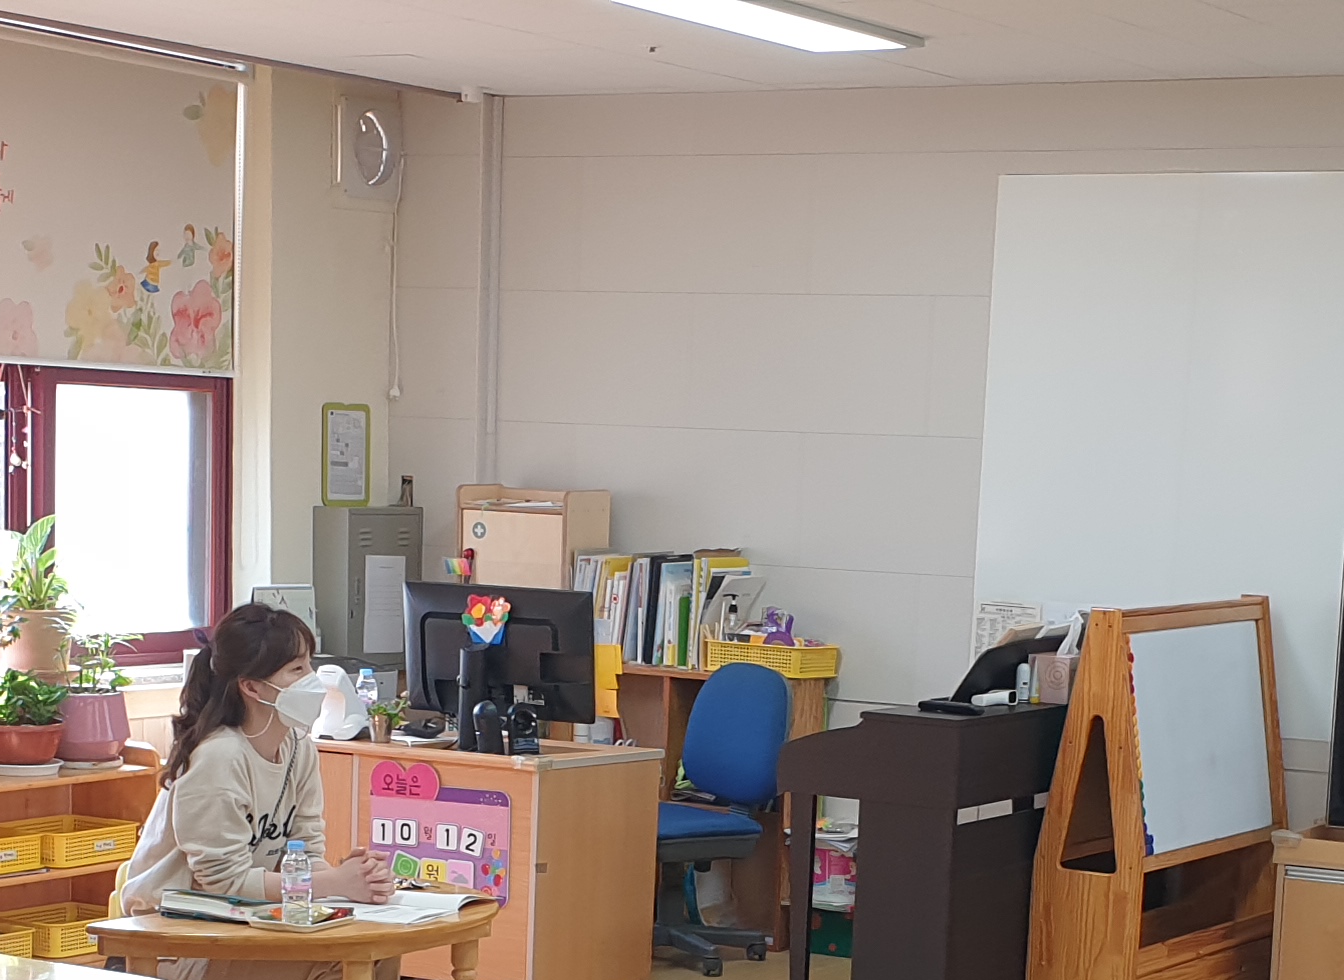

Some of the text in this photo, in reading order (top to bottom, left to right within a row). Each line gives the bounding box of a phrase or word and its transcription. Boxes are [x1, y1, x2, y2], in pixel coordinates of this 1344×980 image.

[381, 773, 422, 797] 오늘은
[379, 822, 412, 842] 10
[443, 827, 478, 853] 12
